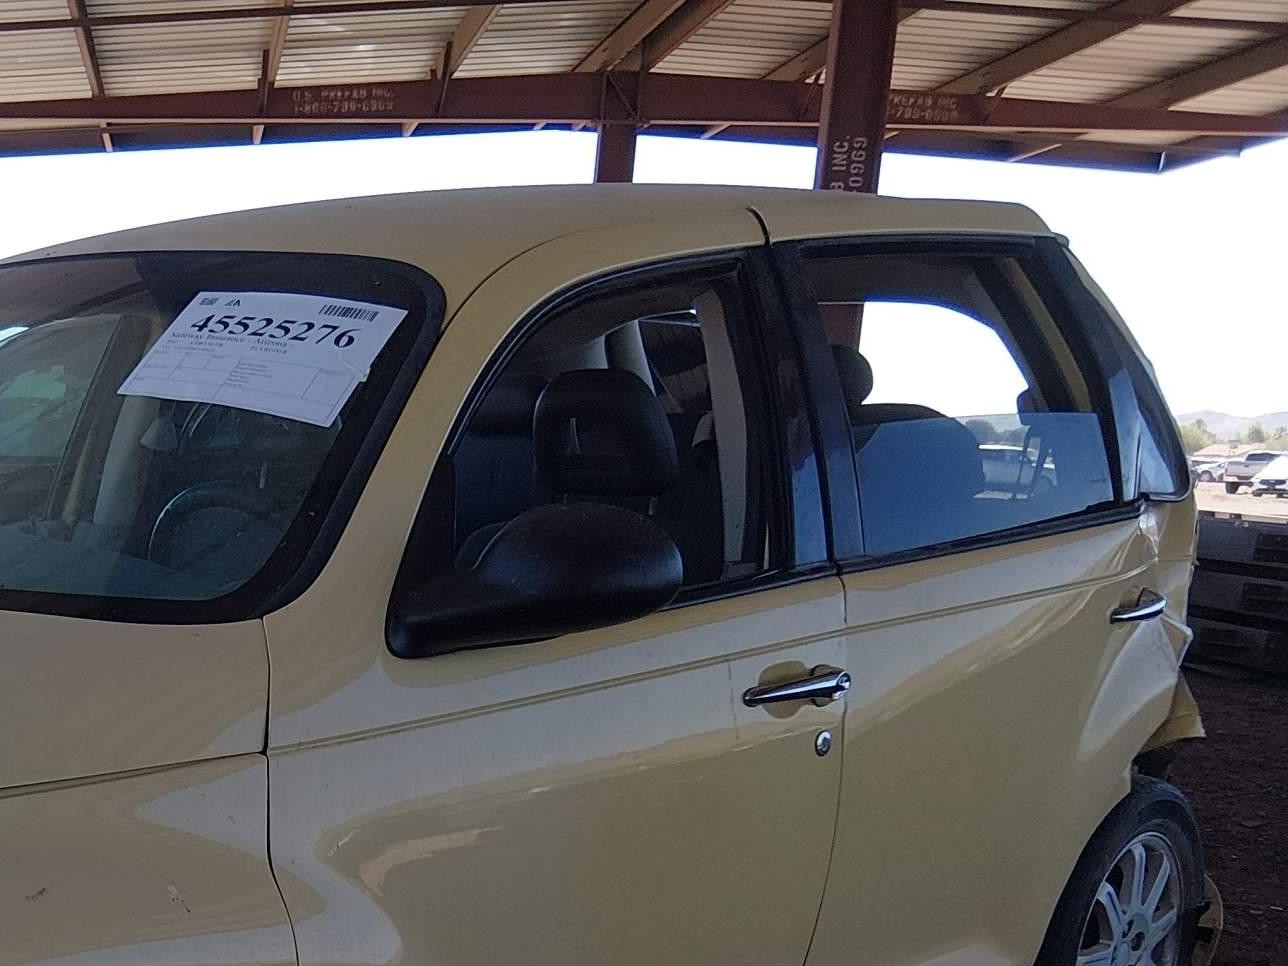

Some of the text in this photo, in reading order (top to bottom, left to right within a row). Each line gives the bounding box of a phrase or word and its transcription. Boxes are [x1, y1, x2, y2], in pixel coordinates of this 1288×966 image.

[320, 88, 367, 100] PREFAB
[832, 135, 850, 170] INC.
[191, 314, 363, 349] 45525276
